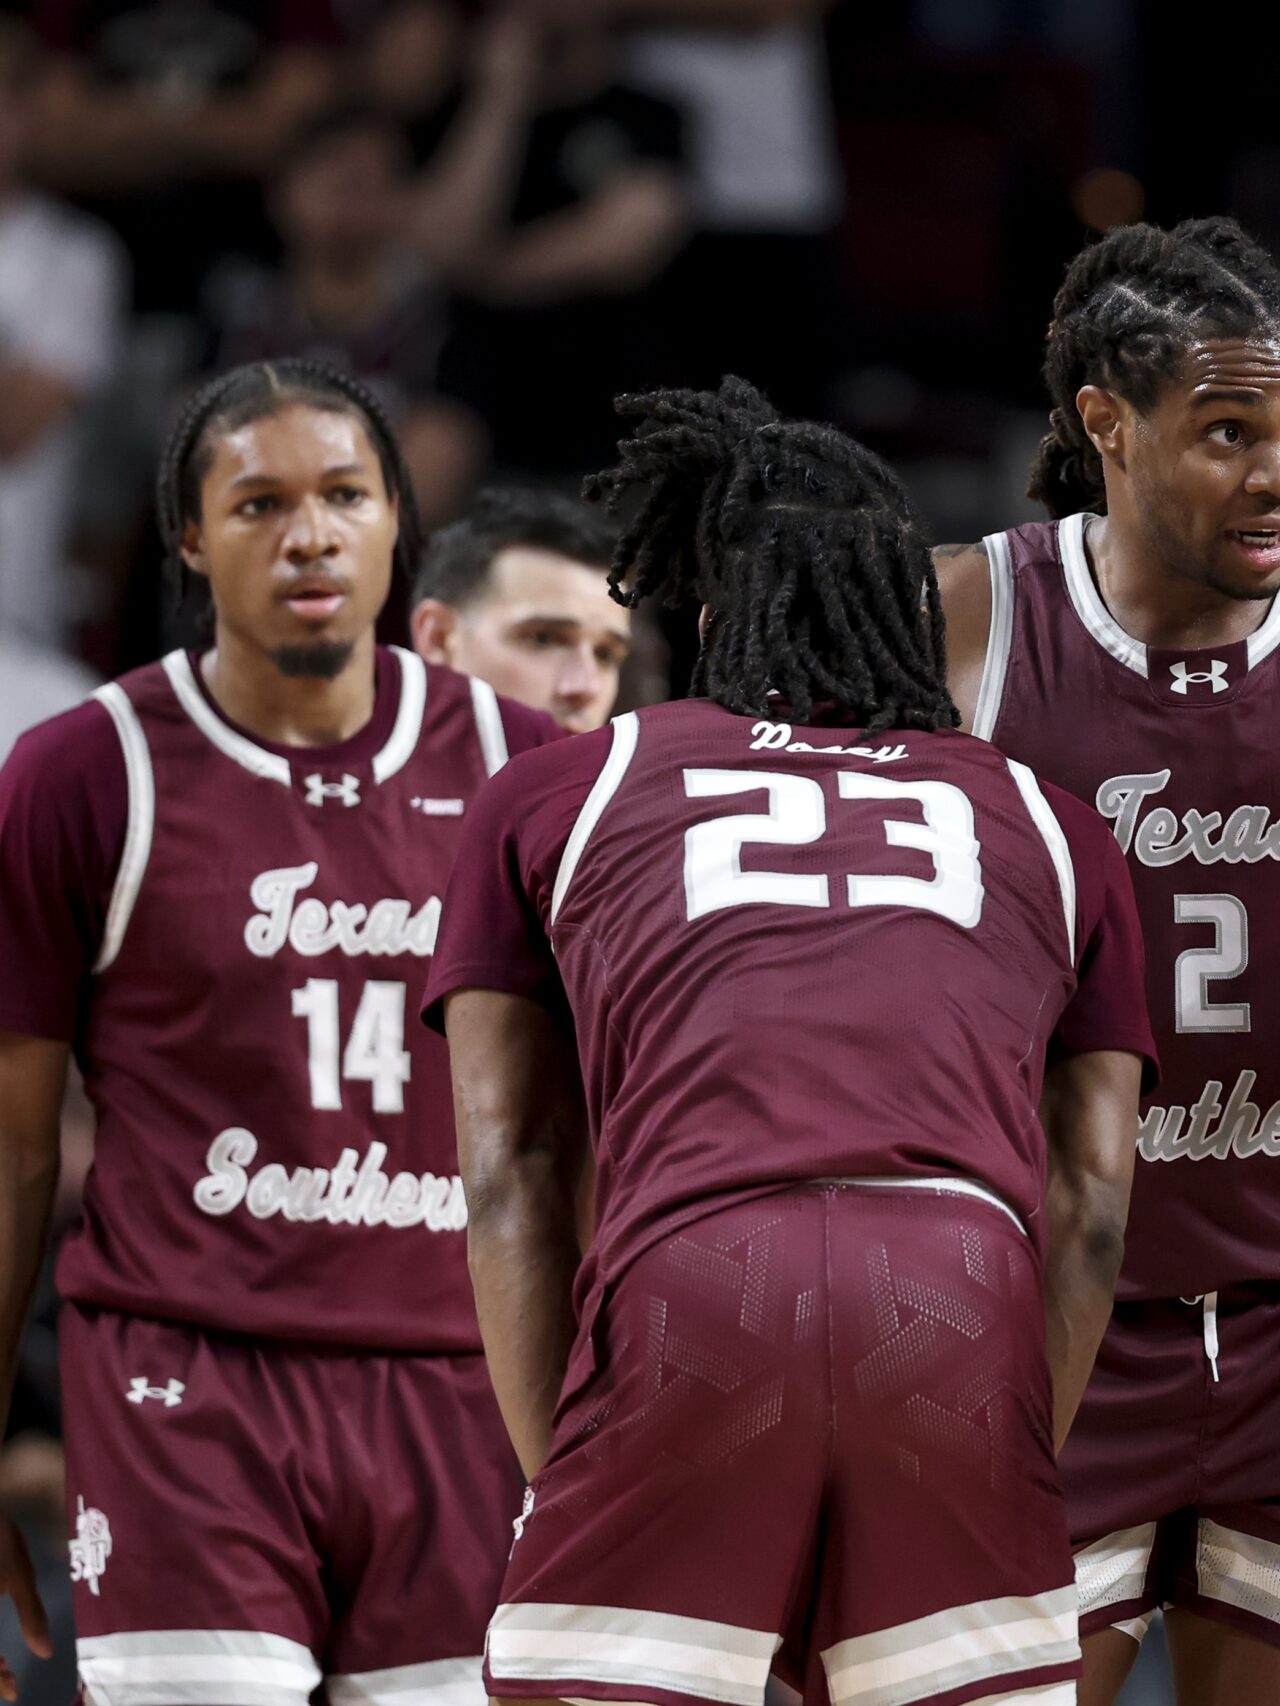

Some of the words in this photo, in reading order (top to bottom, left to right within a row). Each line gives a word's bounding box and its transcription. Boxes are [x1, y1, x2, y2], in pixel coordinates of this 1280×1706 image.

[244, 861, 442, 958] Texas
[683, 768, 984, 928] 23
[1174, 893, 1252, 1034] 2
[292, 977, 411, 1113] 14
